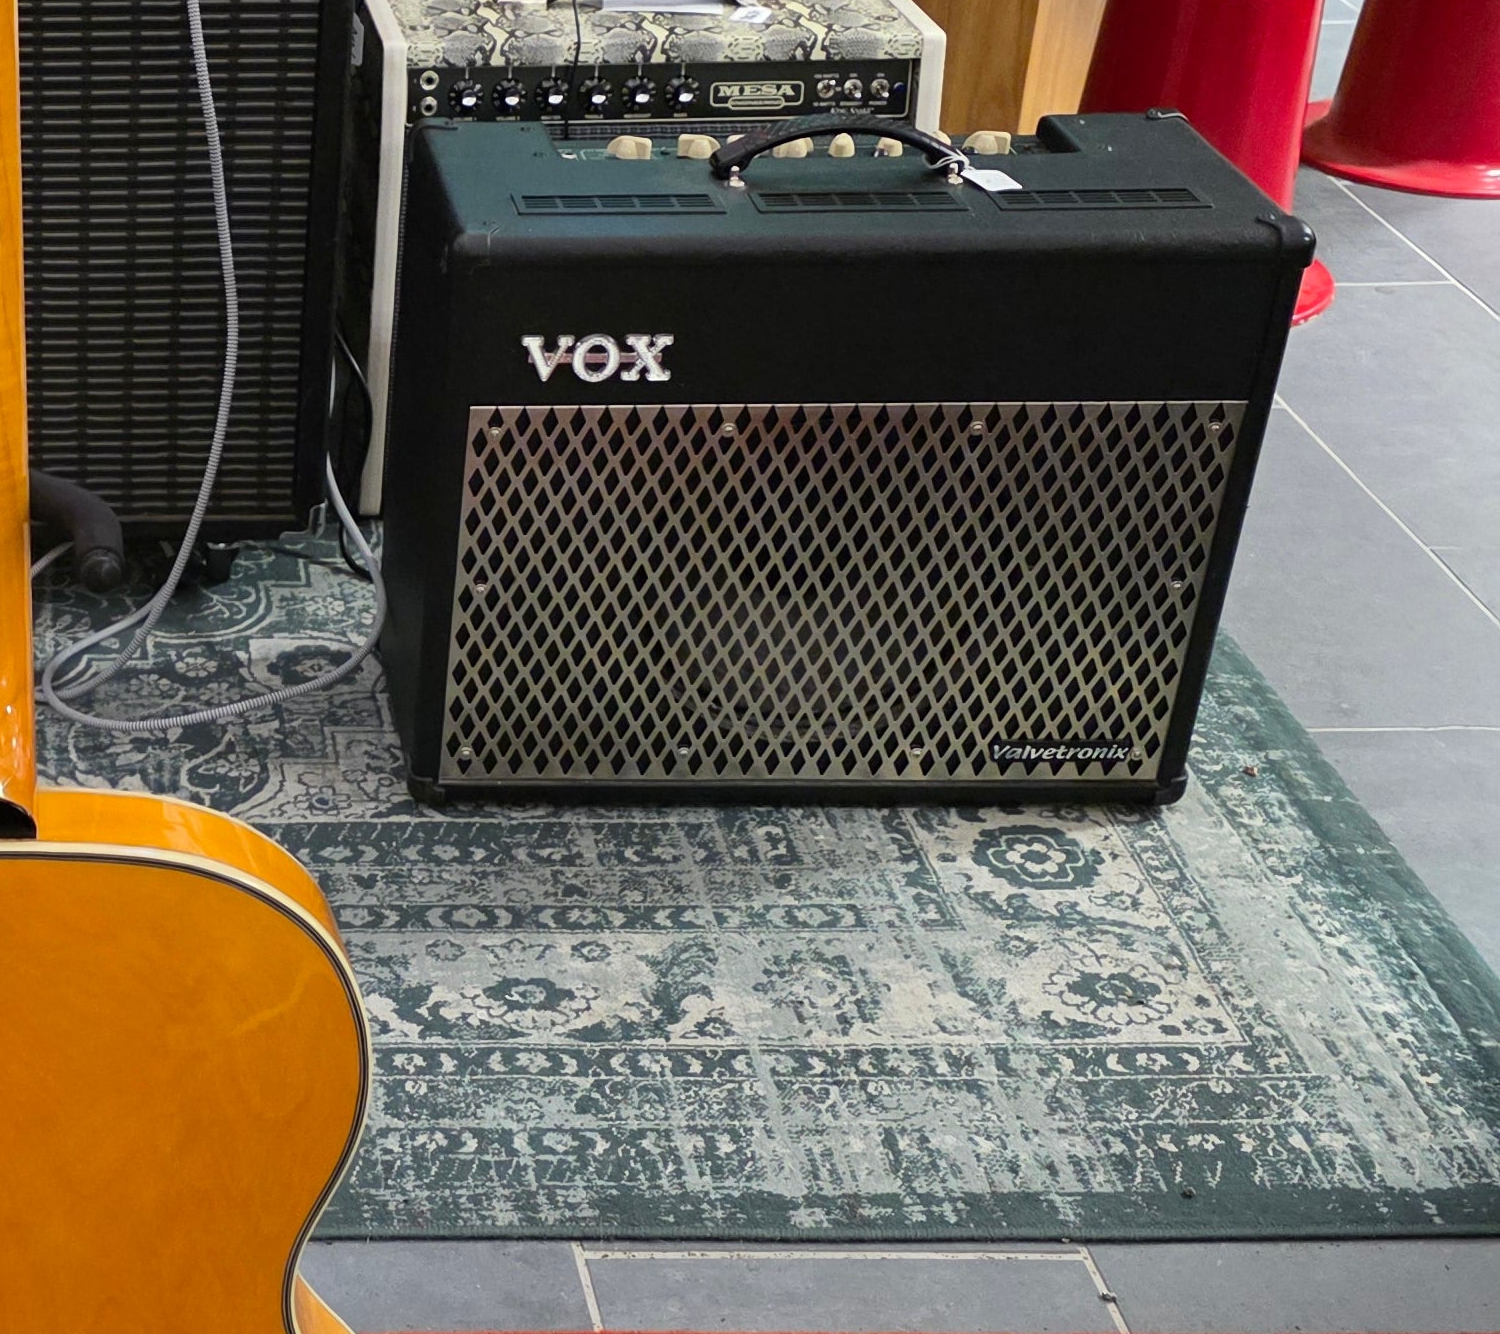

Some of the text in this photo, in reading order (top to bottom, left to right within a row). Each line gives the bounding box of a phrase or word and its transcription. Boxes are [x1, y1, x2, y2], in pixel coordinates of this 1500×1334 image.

[717, 84, 795, 97] MESA
[521, 333, 675, 383] VOX
[993, 744, 1130, 760] Valvetronix
